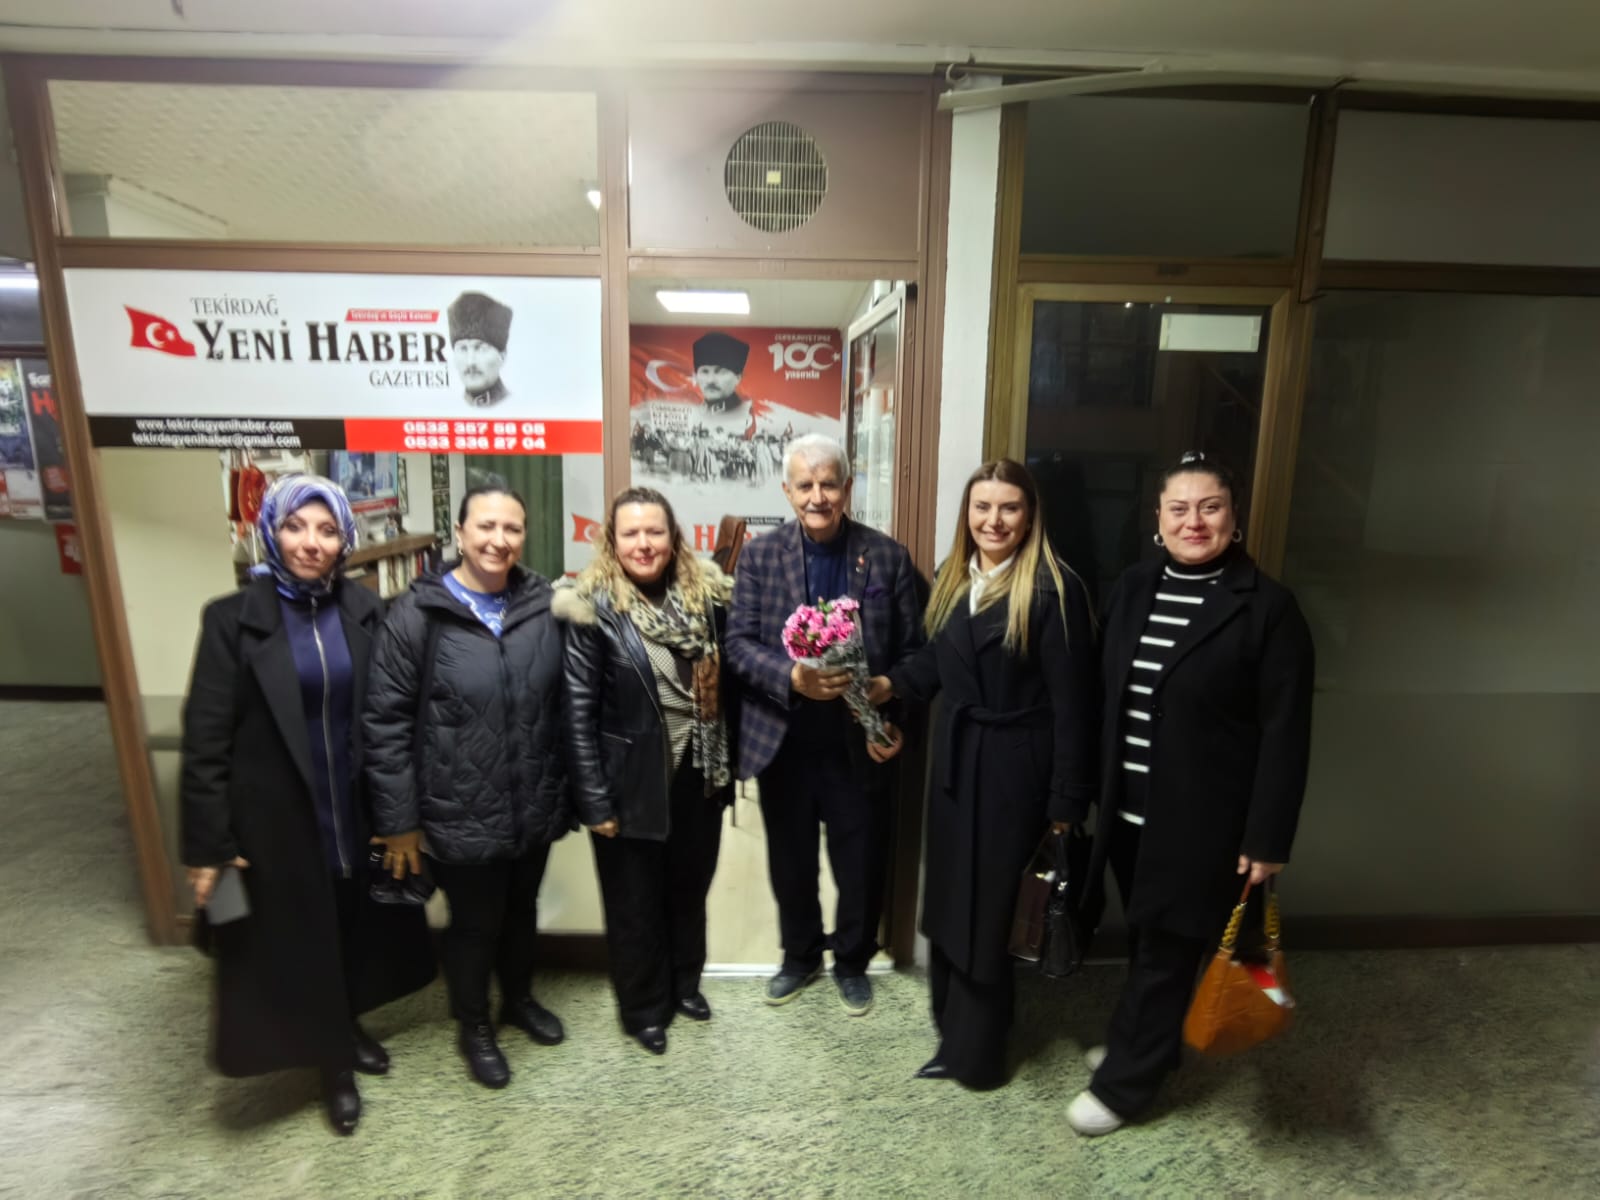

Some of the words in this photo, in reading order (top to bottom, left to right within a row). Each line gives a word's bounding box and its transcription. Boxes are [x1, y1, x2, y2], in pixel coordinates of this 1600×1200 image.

[190, 293, 279, 315] TEKİRDAĞ
[192, 319, 292, 361] YENİ
[305, 321, 448, 362] HABER
[369, 366, 449, 387] GAZETESİ
